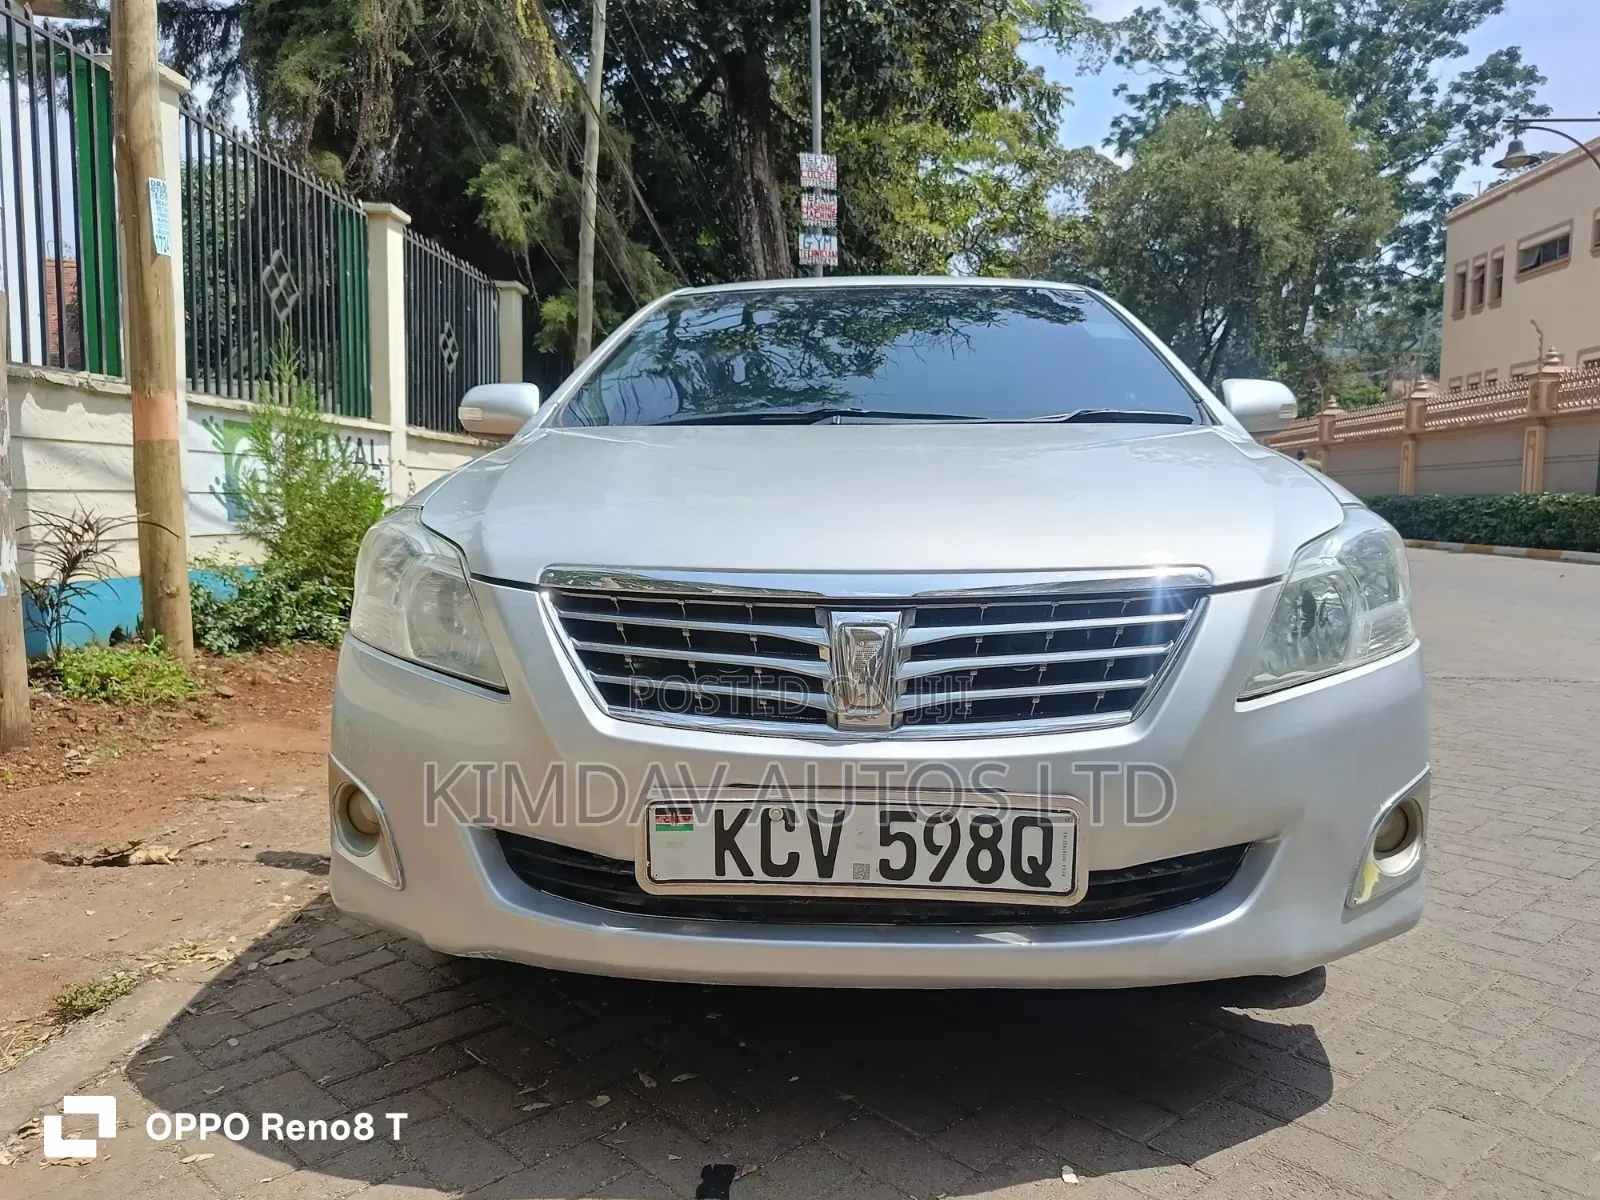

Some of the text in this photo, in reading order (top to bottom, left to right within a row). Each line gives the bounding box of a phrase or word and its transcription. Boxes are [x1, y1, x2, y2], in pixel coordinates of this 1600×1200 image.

[803, 234, 832, 251] GYM
[714, 807, 1054, 888] KCV 598Q
